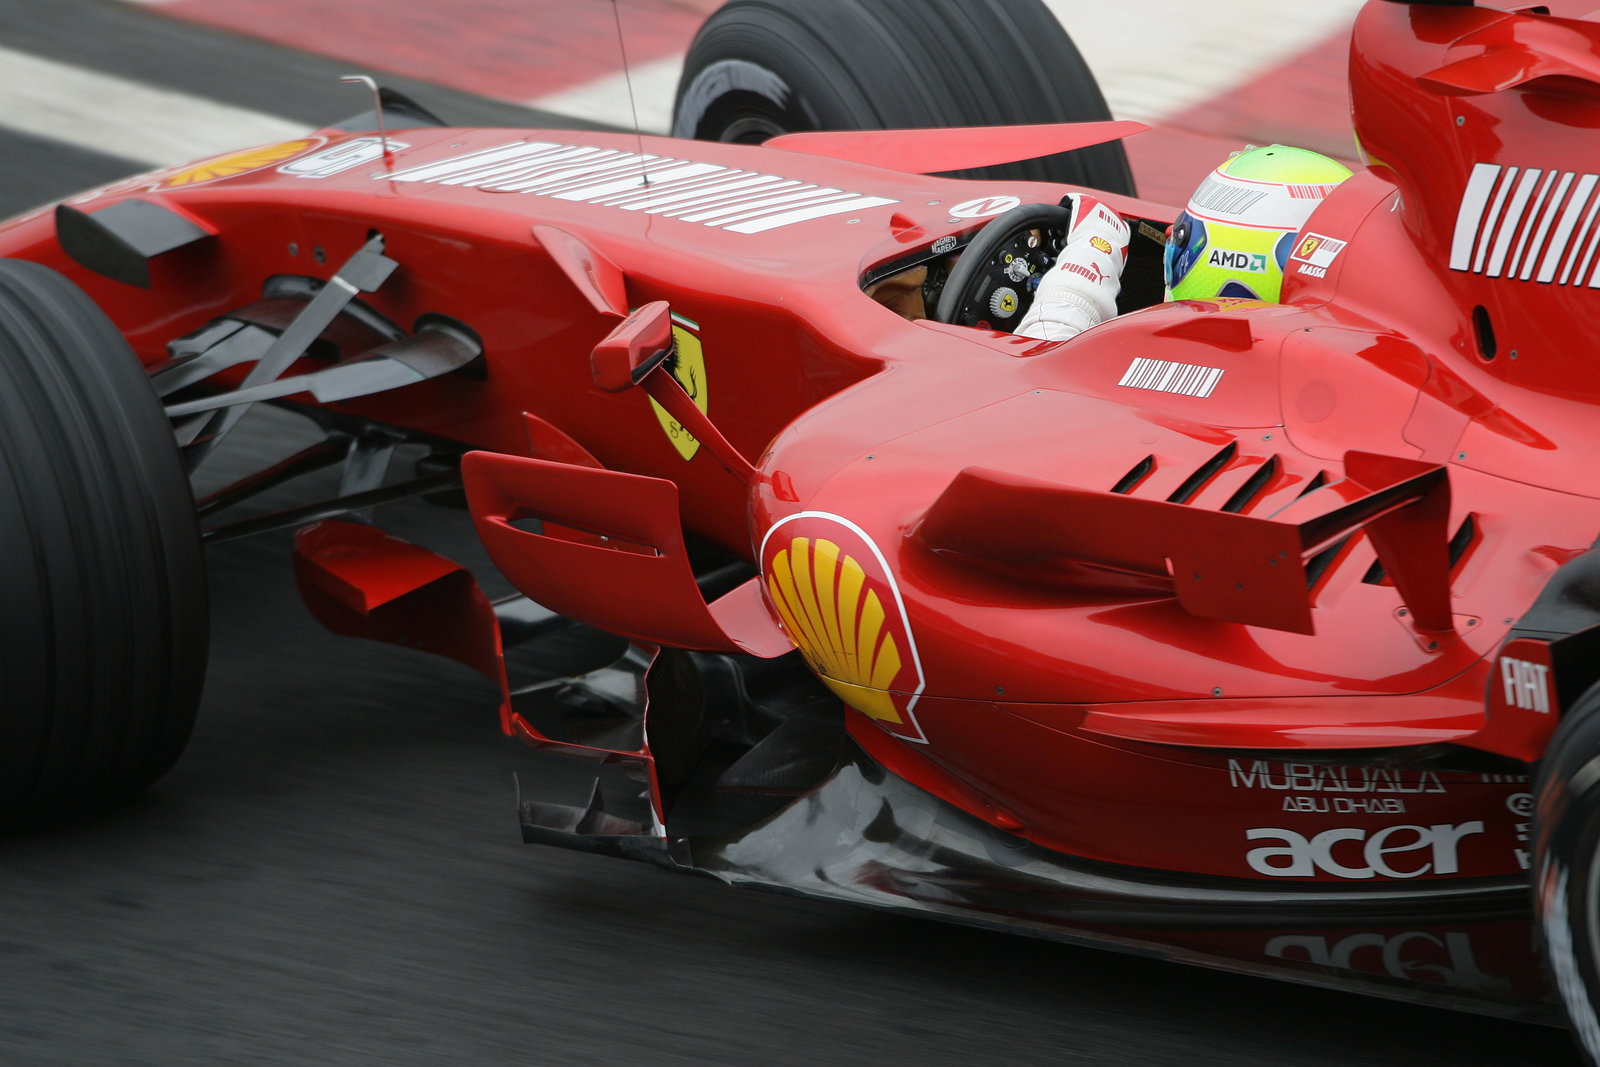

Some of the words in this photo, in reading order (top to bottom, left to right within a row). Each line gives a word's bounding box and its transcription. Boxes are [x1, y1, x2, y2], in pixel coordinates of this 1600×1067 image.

[1209, 249, 1249, 268] AMD
[1060, 262, 1098, 283] PUMA
[1297, 264, 1327, 278] MASSA
[1500, 656, 1550, 714] FIAT
[1227, 758, 1447, 793] MUBADALA
[1282, 796, 1330, 812] ABU
[1333, 797, 1407, 813] DHABI
[1246, 820, 1484, 879] acer
